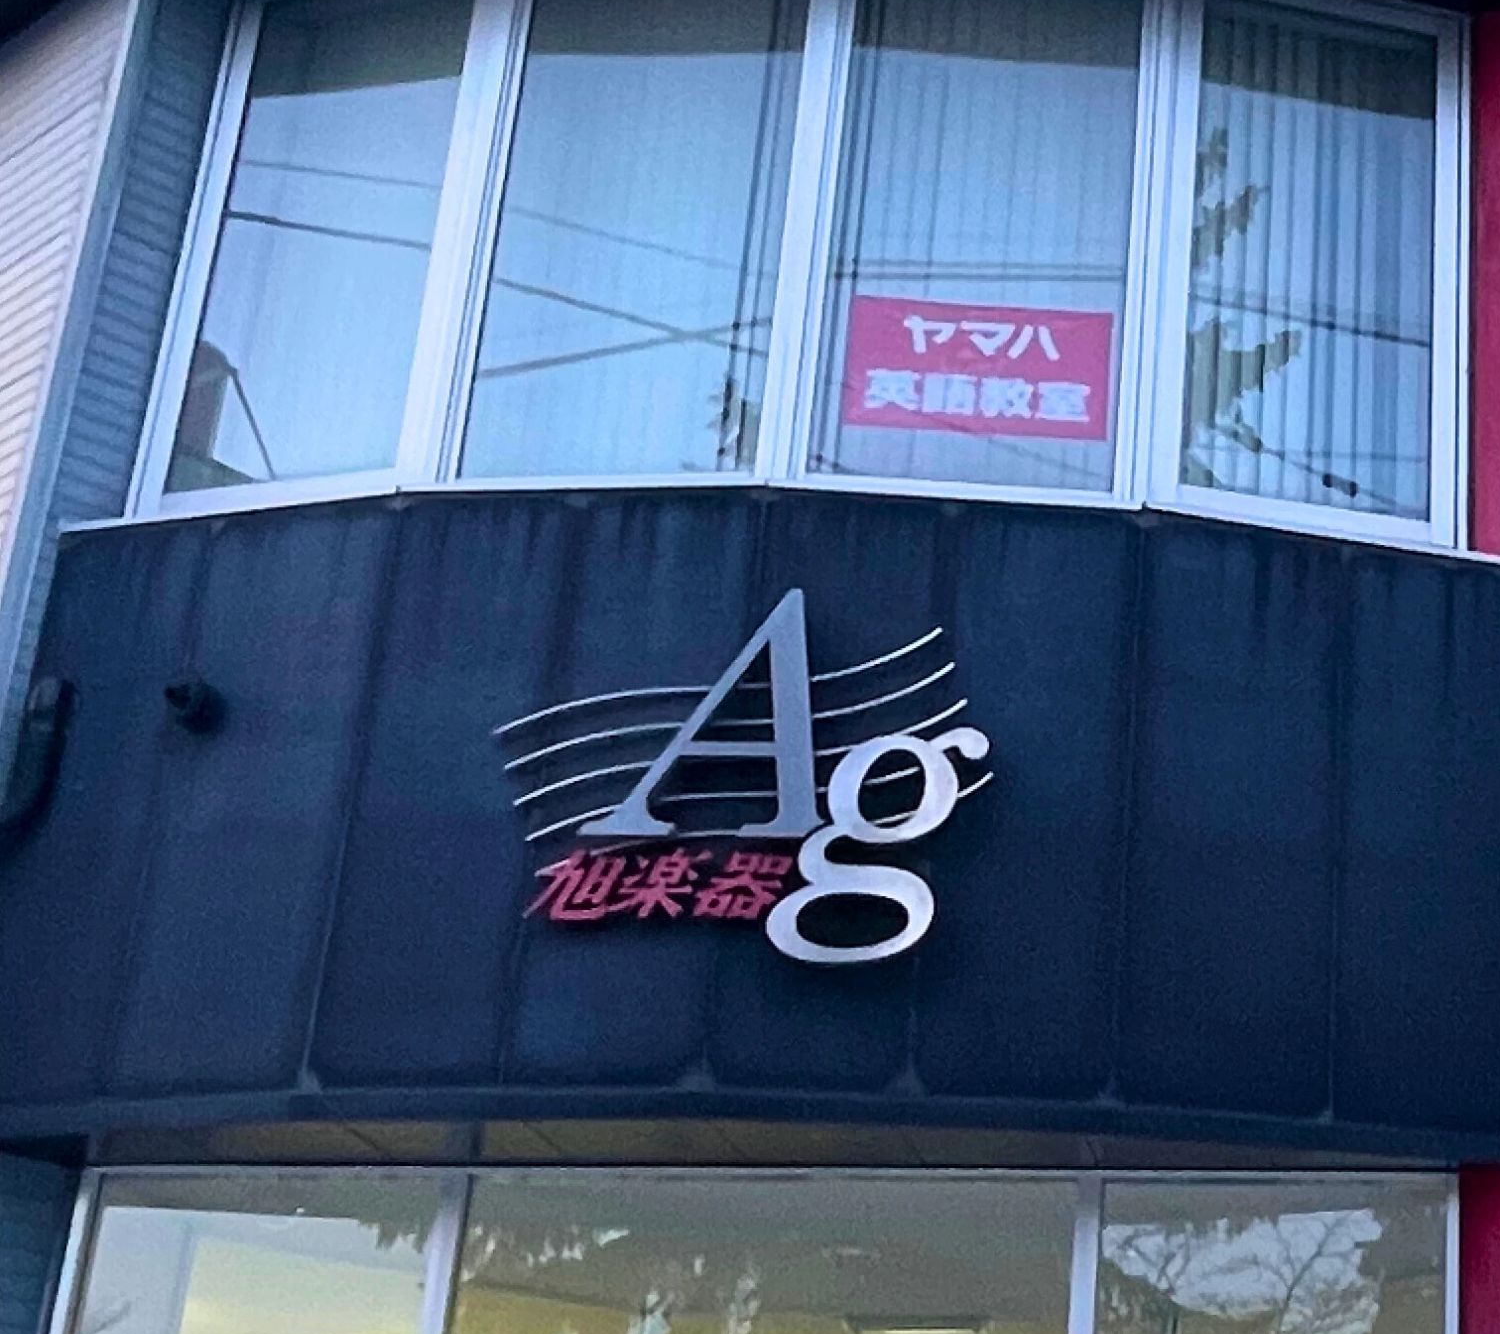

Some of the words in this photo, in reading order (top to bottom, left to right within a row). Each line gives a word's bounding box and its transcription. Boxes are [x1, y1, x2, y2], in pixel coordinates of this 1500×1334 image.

[902, 314, 1061, 361] ヤマハ
[576, 587, 990, 963] Ag
[523, 846, 797, 921] 旭楽器
